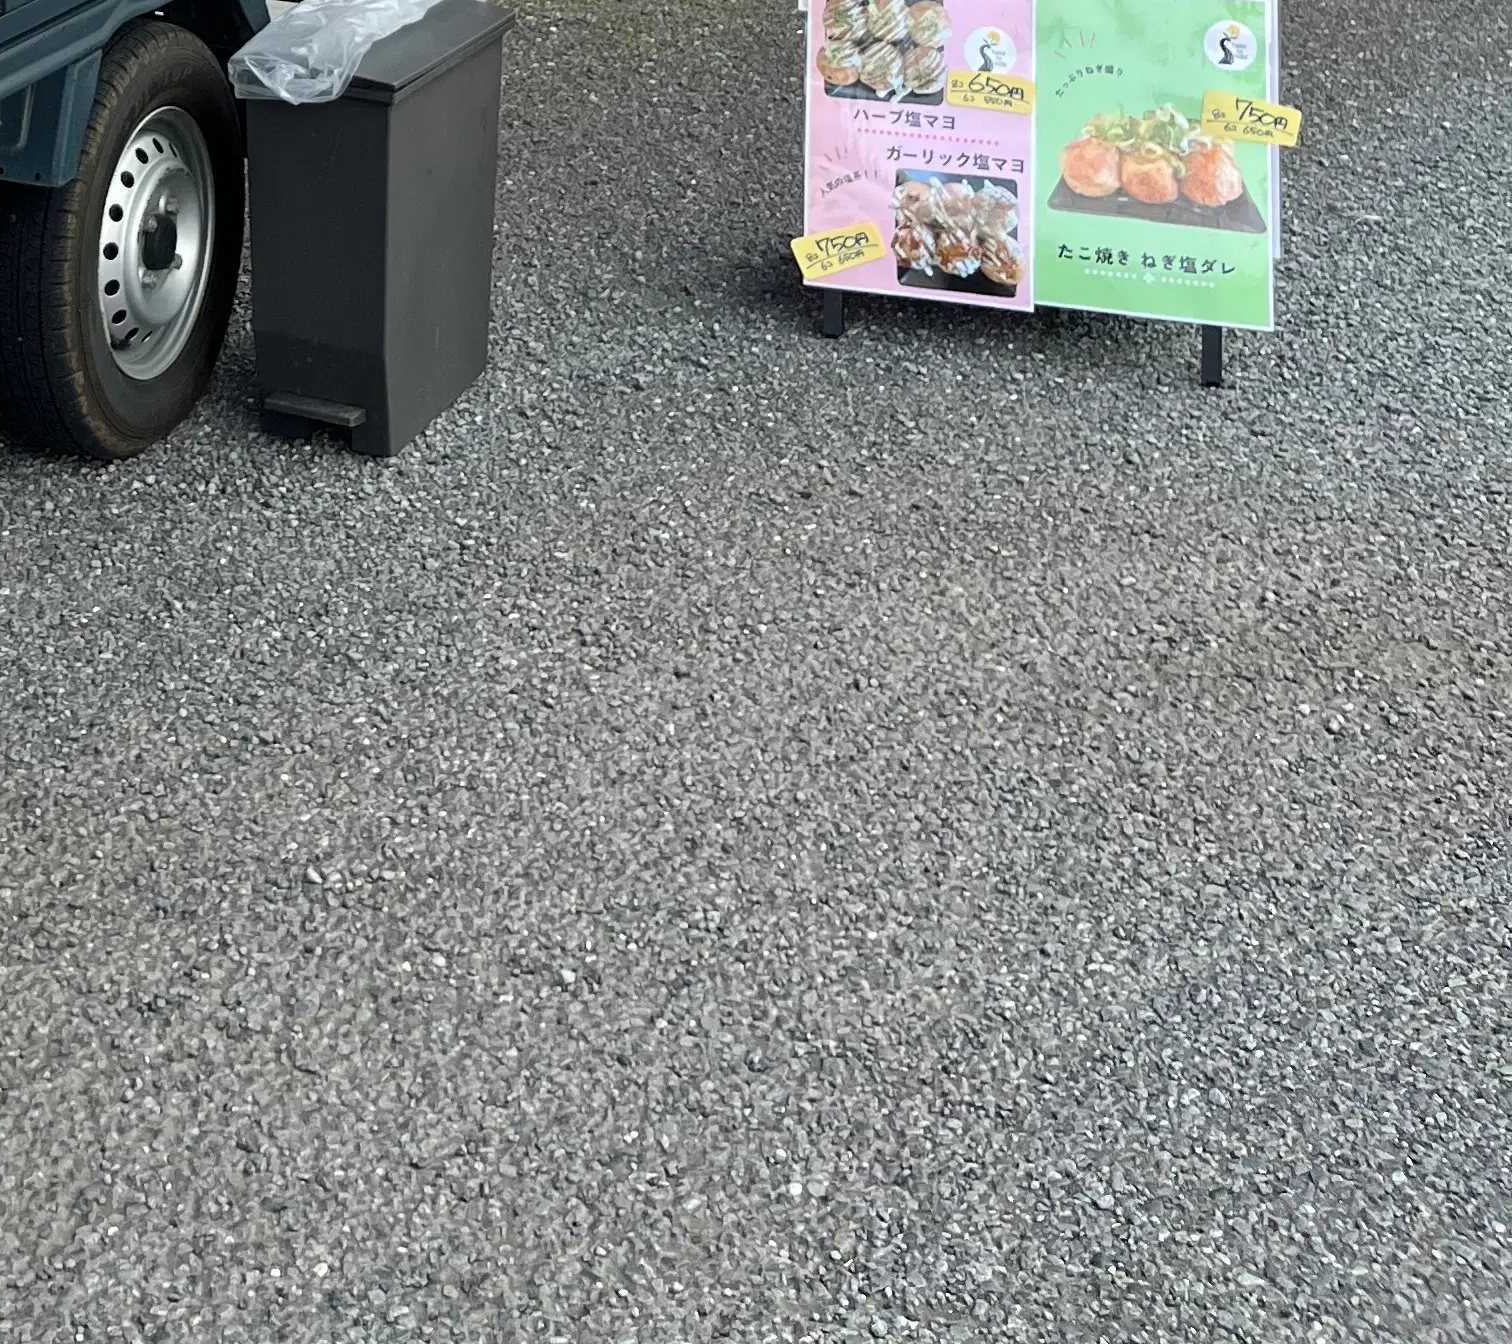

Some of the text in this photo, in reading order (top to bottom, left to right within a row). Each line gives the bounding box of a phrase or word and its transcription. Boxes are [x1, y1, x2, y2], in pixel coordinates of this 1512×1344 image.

[968, 73, 1024, 101] 650円
[853, 108, 956, 130] ハーブ塩マヨ
[1235, 97, 1288, 130] 750円
[886, 145, 1025, 174] ガーリック塩マヨ
[815, 231, 869, 258] 750円
[1057, 243, 1236, 275] たこ焼き ねぎ塩ダレ
